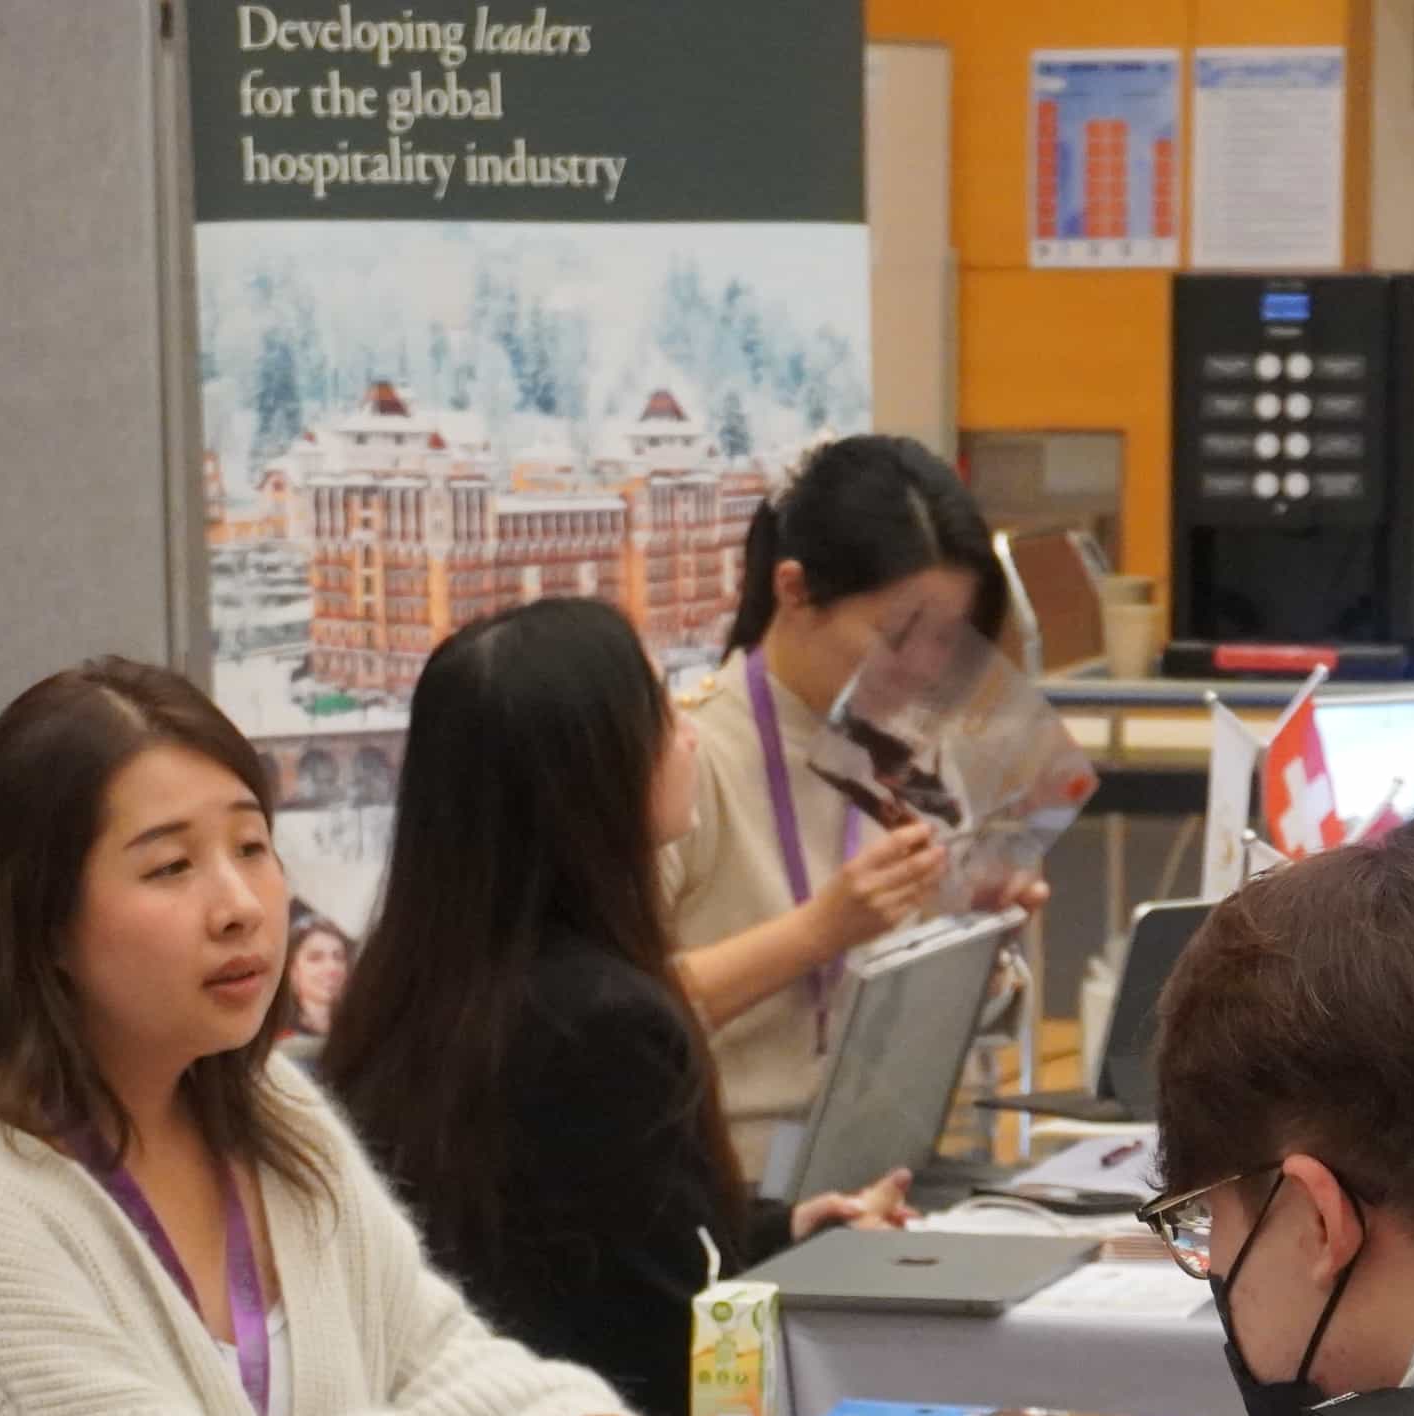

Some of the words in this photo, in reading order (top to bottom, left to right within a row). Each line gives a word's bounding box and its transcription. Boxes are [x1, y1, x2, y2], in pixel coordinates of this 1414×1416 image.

[238, 4, 467, 66] Developing
[473, 4, 591, 55] leaders
[239, 69, 299, 118] for
[311, 71, 379, 118] the
[387, 71, 504, 131] global
[242, 135, 455, 199] hospitality
[465, 139, 627, 201] industry
